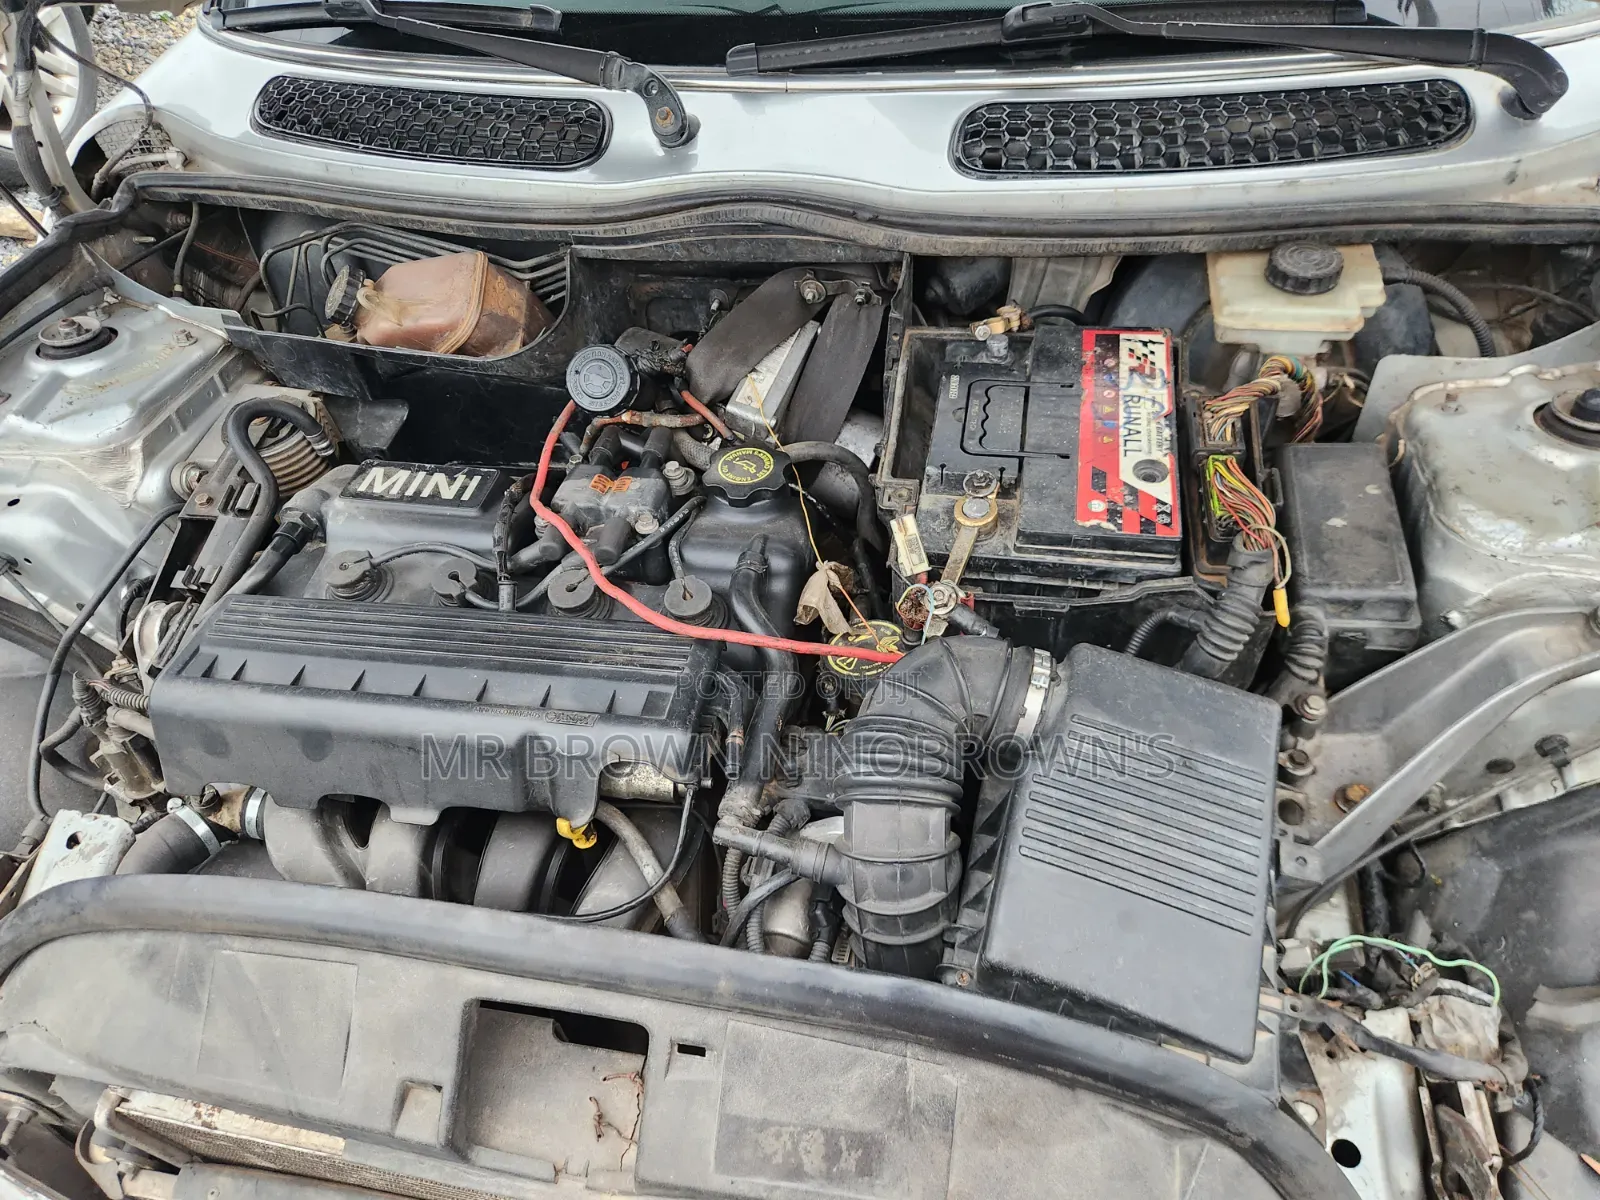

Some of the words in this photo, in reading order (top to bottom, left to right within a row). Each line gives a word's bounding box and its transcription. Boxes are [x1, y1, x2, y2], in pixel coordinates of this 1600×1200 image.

[1122, 394, 1142, 458] RUNALL
[725, 450, 753, 462] MANUAL
[357, 467, 482, 501] MINI
[725, 471, 752, 482] ENGINE
